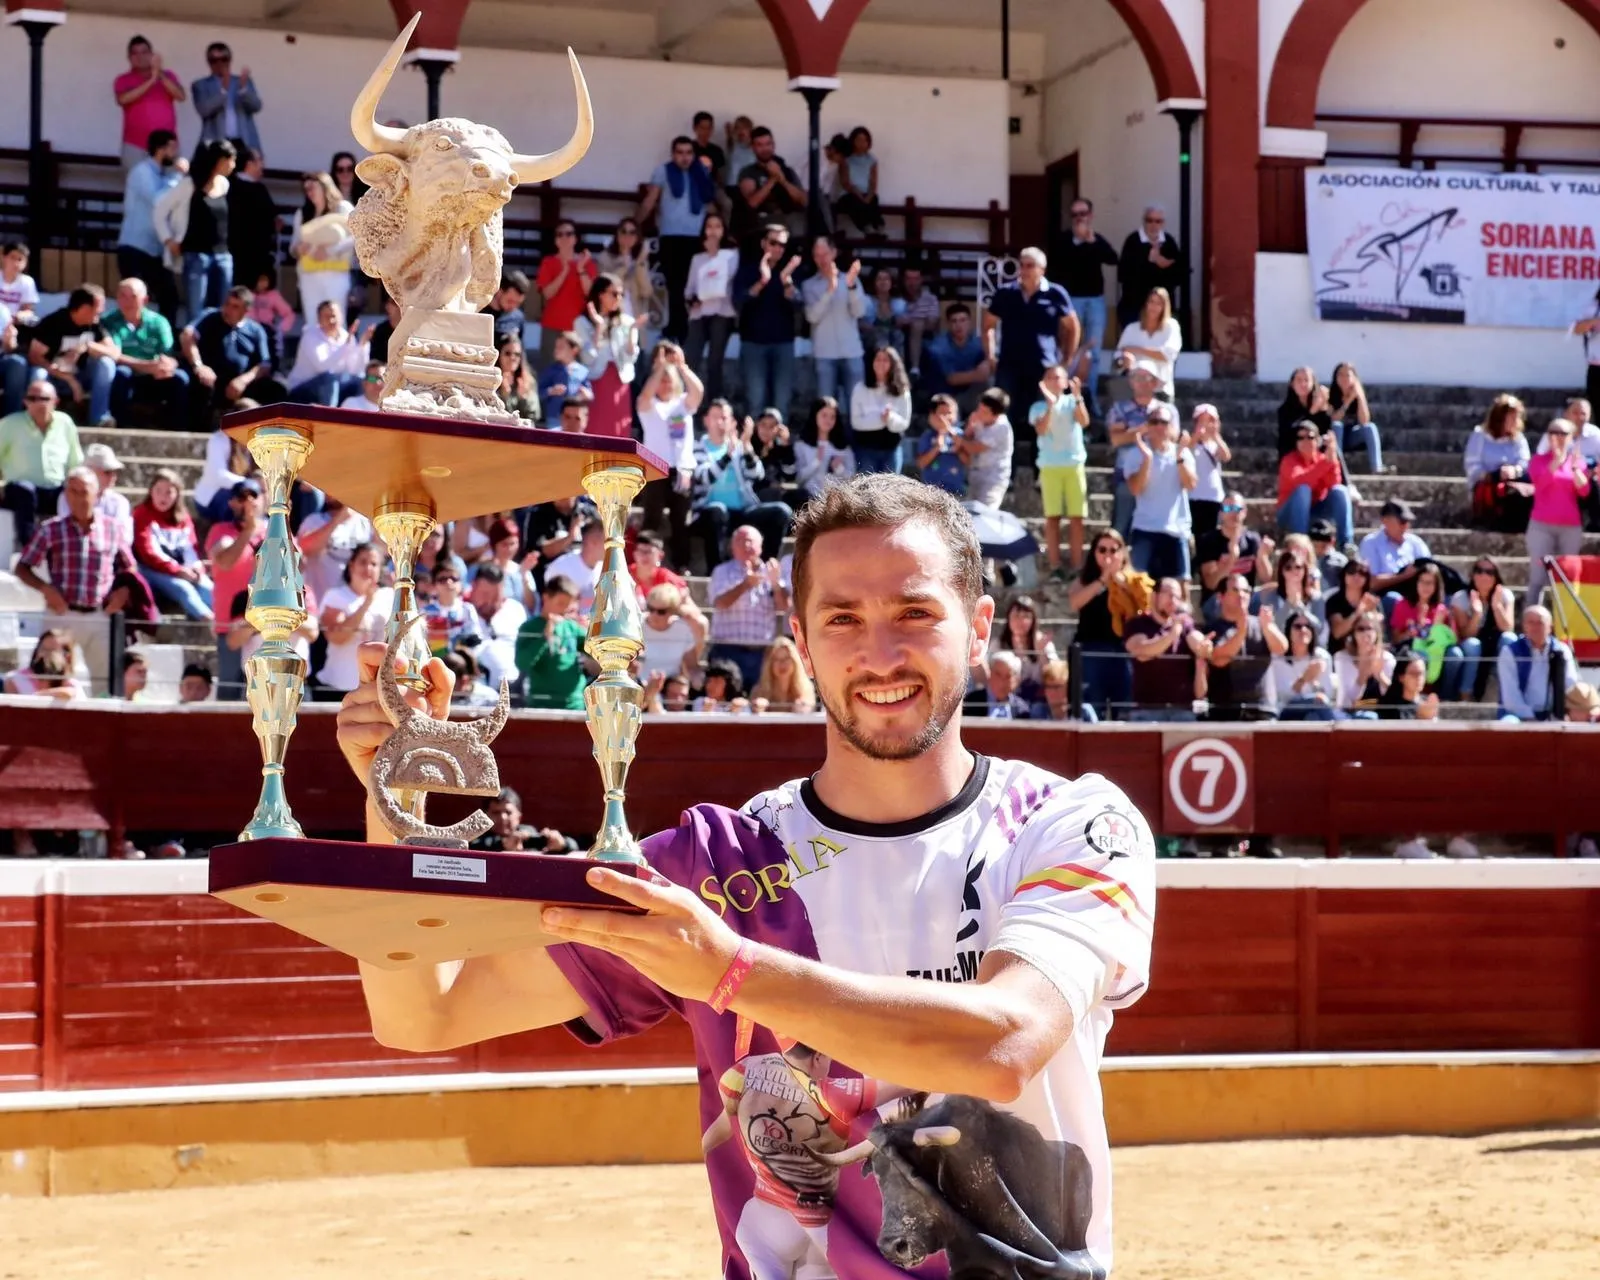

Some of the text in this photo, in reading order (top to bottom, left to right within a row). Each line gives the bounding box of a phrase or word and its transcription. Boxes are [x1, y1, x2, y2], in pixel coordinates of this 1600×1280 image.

[1318, 171, 1440, 190] ASOCIACIÓN
[1446, 177, 1544, 194] CULTURAL
[1549, 181, 1561, 193] Y
[1480, 222, 1595, 250] SORIANA
[1487, 252, 1600, 281] ENCIERR
[1191, 755, 1224, 807] 7
[699, 831, 849, 919] SORIA
[762, 1118, 784, 1140] YO
